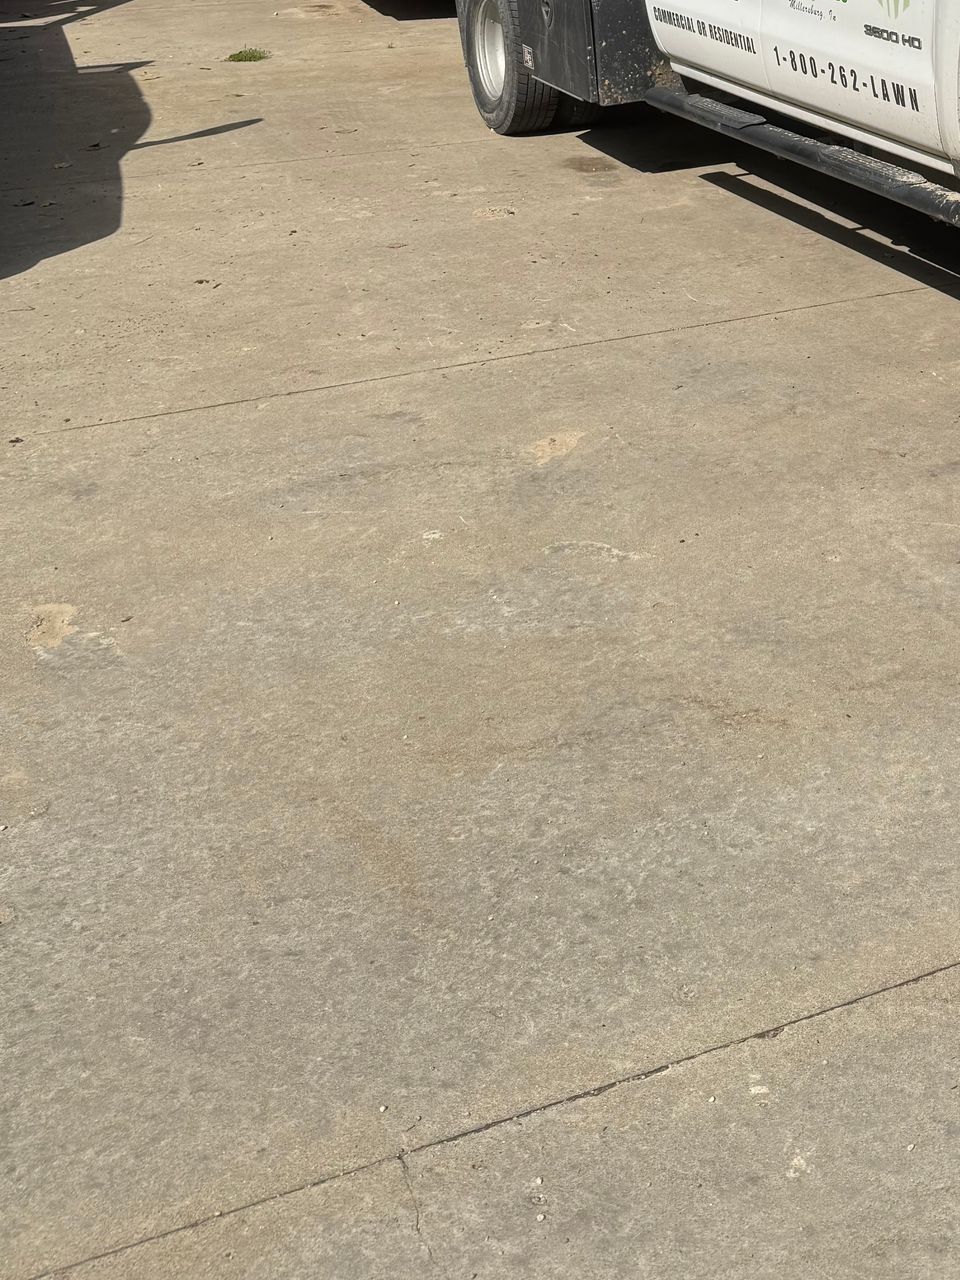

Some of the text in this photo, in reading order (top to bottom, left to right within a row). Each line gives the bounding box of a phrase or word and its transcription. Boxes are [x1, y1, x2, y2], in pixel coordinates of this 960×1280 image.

[653, 6, 757, 54] COMMERCIAL OR RESIDENTIAL
[863, 23, 923, 50] 3500 HD
[773, 45, 920, 112] 1-800-262-LAWN
